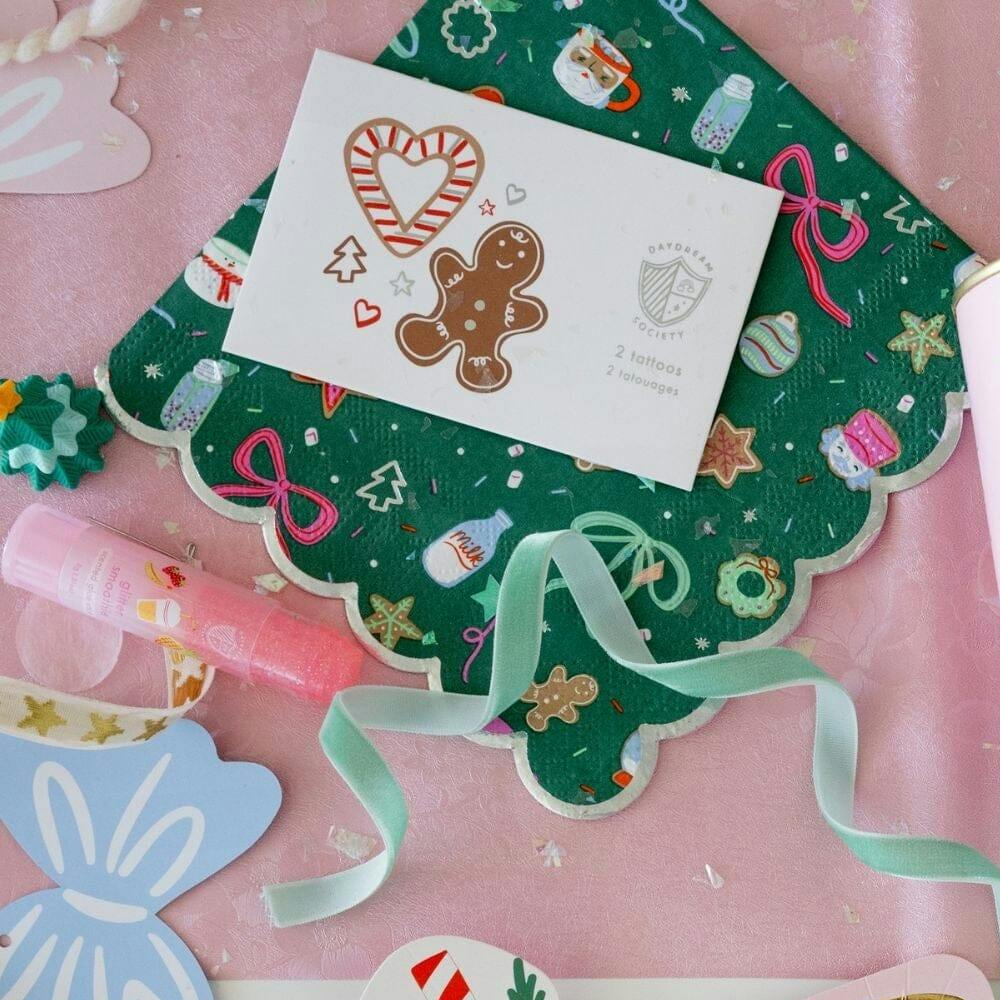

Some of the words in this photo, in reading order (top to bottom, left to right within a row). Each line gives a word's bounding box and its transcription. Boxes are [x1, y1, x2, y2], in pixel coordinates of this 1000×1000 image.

[648, 242, 714, 273] DAYDREAM
[632, 316, 685, 341] SOCIETY
[615, 345, 625, 358] 2
[630, 350, 682, 377] tattoos
[606, 365, 616, 376] 2
[618, 369, 679, 396] tatouages
[449, 529, 486, 568] Milk
